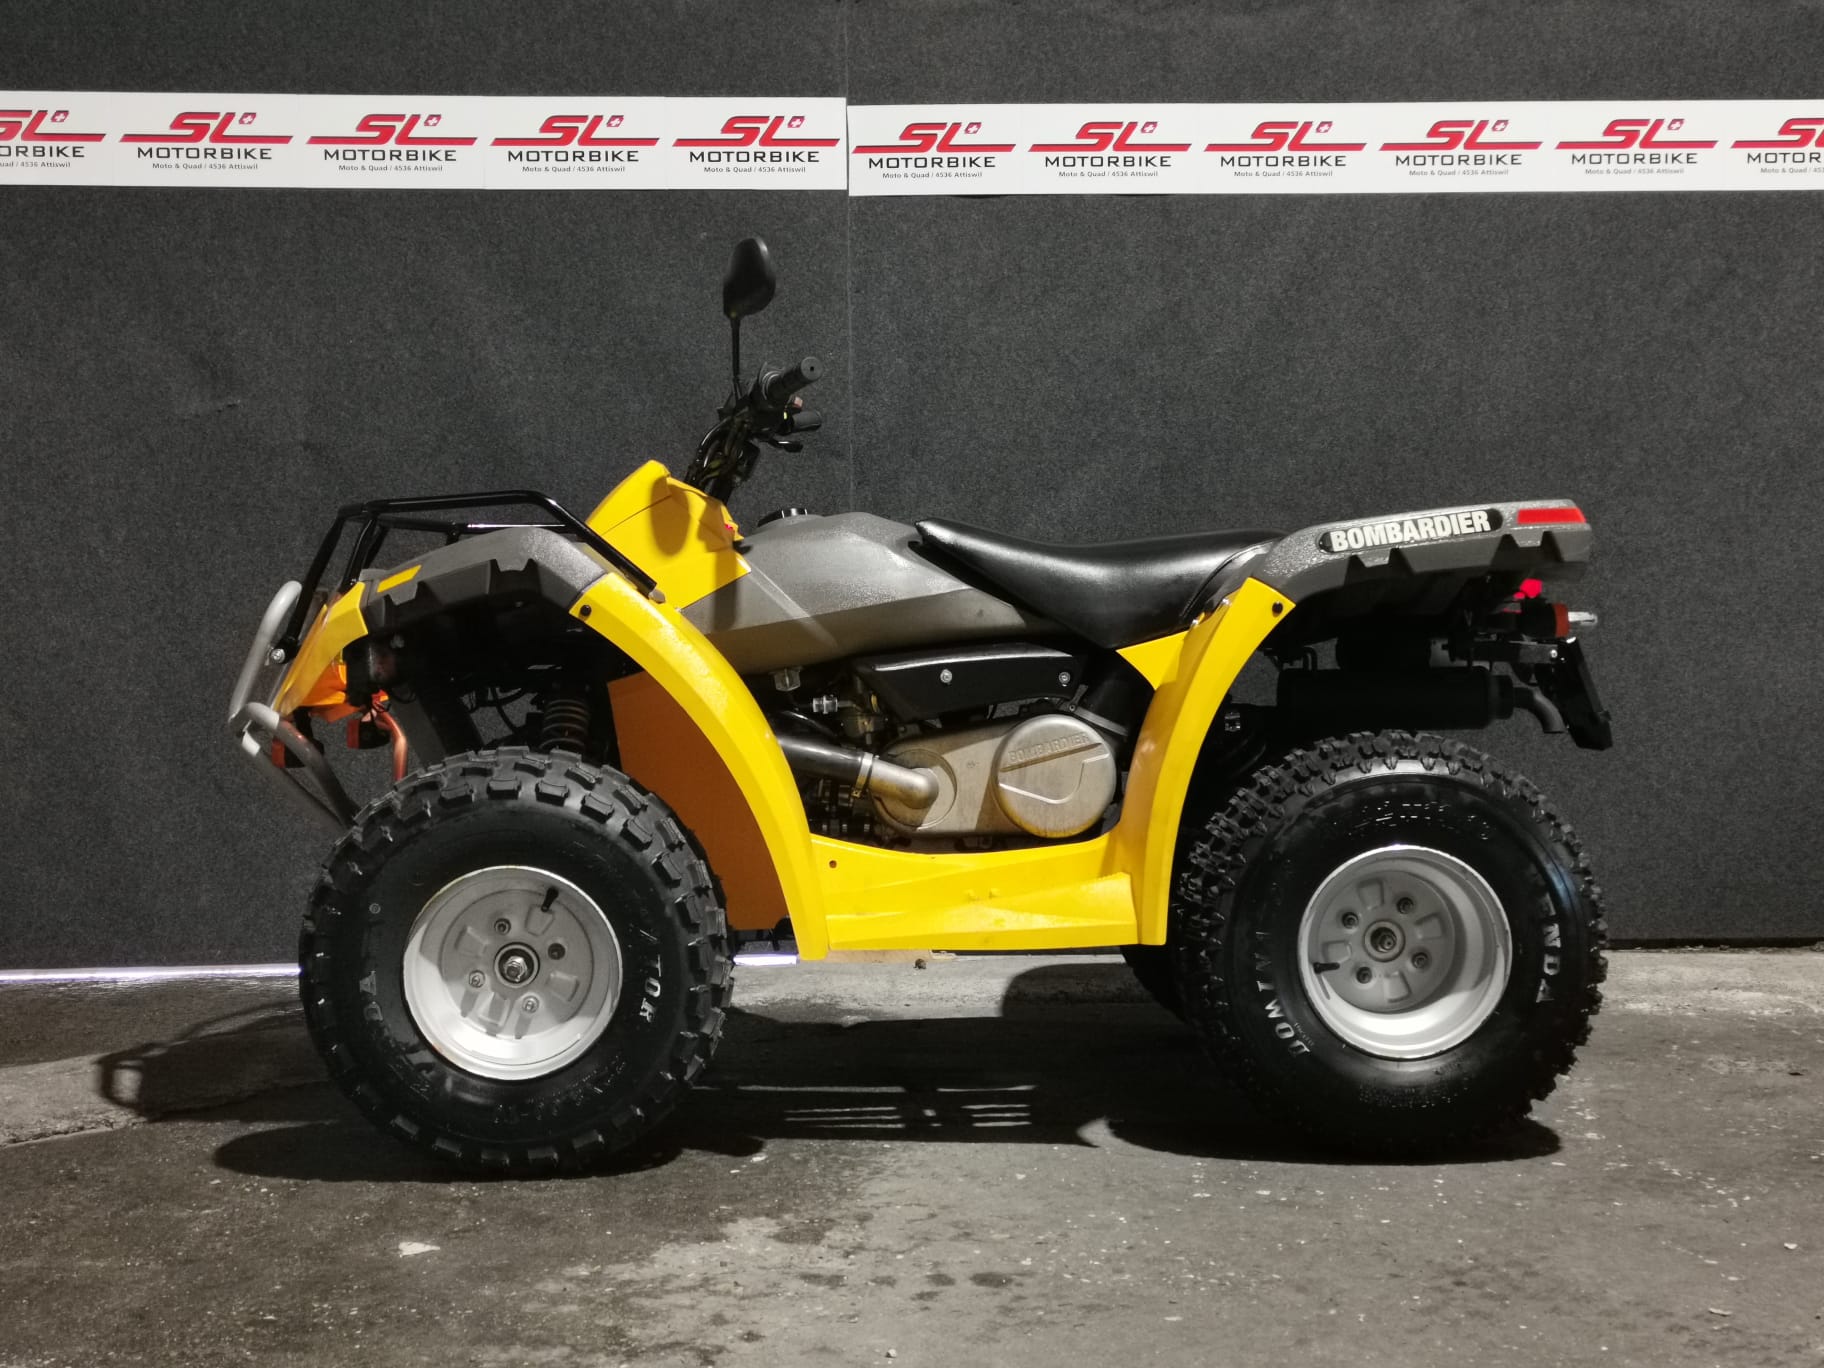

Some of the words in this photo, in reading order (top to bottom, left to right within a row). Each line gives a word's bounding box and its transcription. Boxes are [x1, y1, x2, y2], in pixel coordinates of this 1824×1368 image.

[0, 145, 85, 158] ORBIKE
[137, 147, 272, 160] MOTORBIKE
[324, 149, 456, 162] MOTORBIKE
[507, 150, 639, 162] MOTORBIKE
[689, 151, 820, 163] MOTORBIKE
[1747, 152, 1822, 164] MOTOR
[868, 156, 995, 169] MOTORBIKE
[1045, 155, 1171, 168] MOTORBIKE
[1220, 155, 1346, 167] MOTORBIKE
[1395, 154, 1521, 166] MOTORBIKE
[1571, 152, 1697, 165] MOTORBIKE
[1329, 510, 1491, 552] BOMBARDIER
